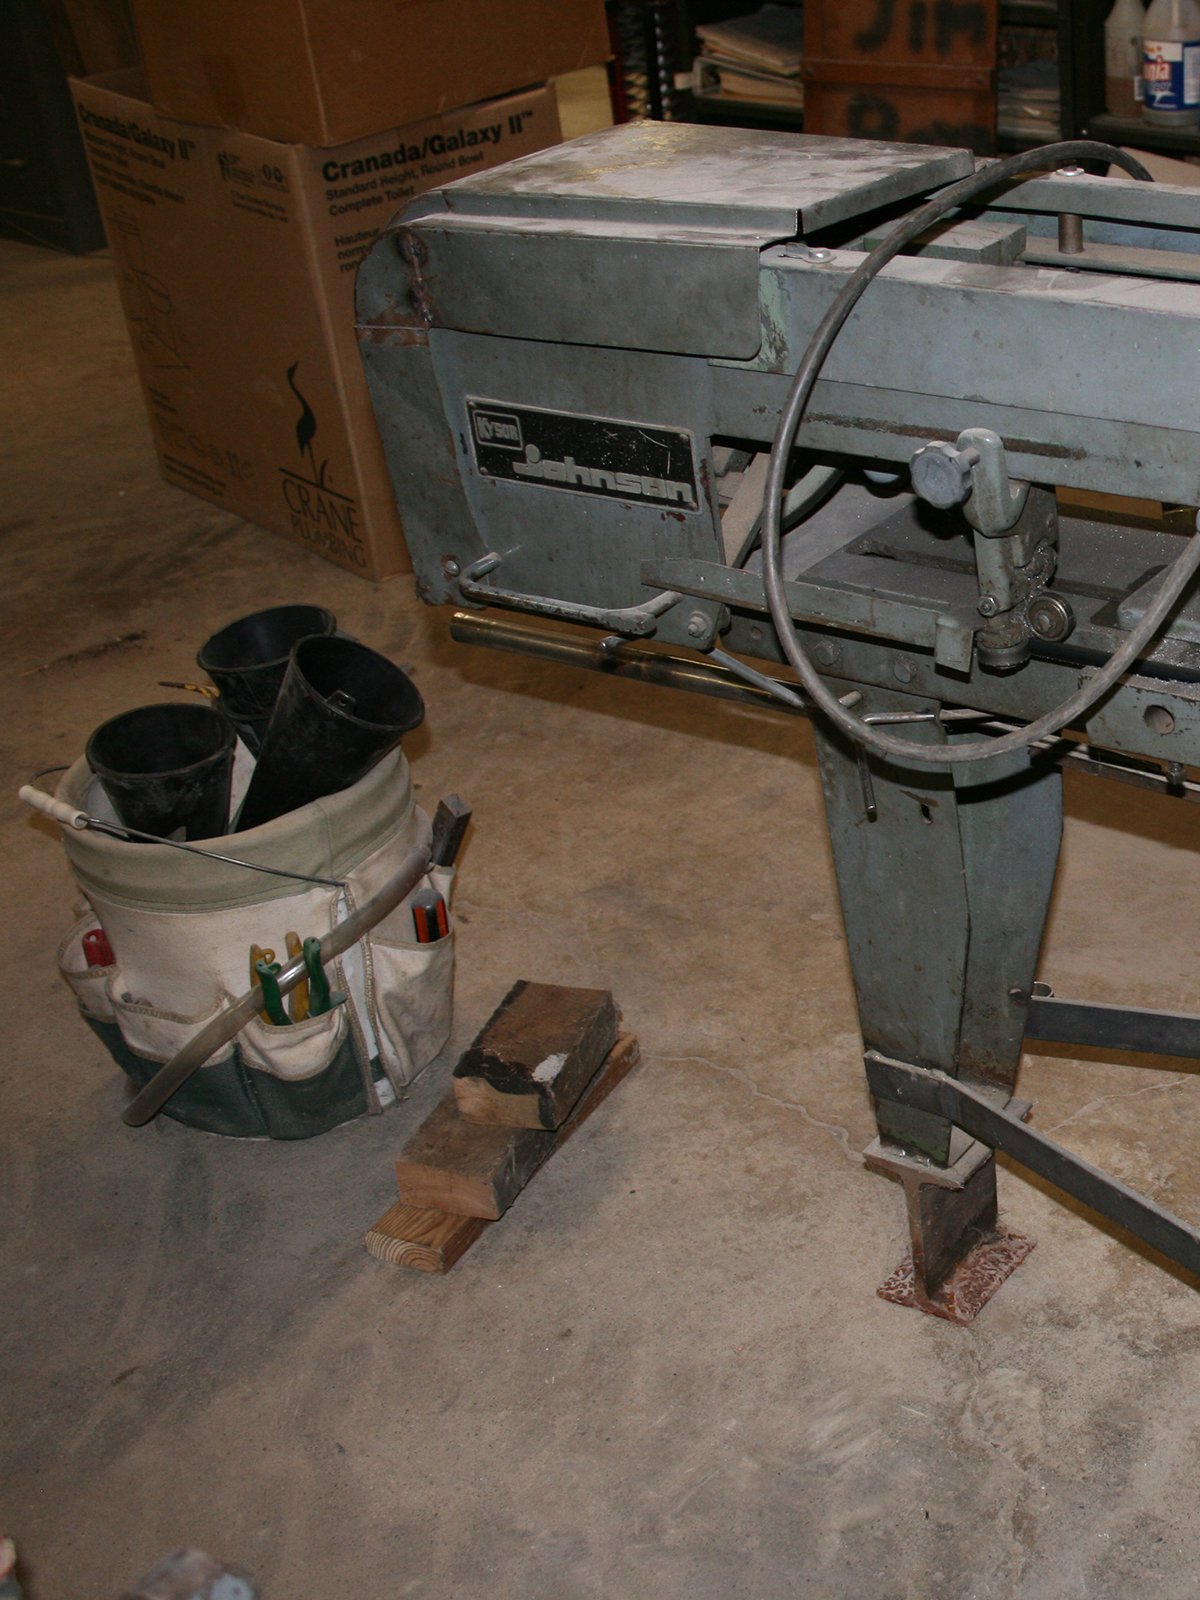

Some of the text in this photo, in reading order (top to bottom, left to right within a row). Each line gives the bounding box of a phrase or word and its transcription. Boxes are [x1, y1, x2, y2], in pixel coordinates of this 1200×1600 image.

[322, 123, 503, 182] Cranada/Galaxy
[326, 151, 485, 200] Standard Height, Round Bowl
[329, 185, 416, 216] Complete Toilet
[335, 227, 381, 247] Hauteur
[476, 415, 520, 441] KYSOR
[282, 479, 363, 543] CRANE
